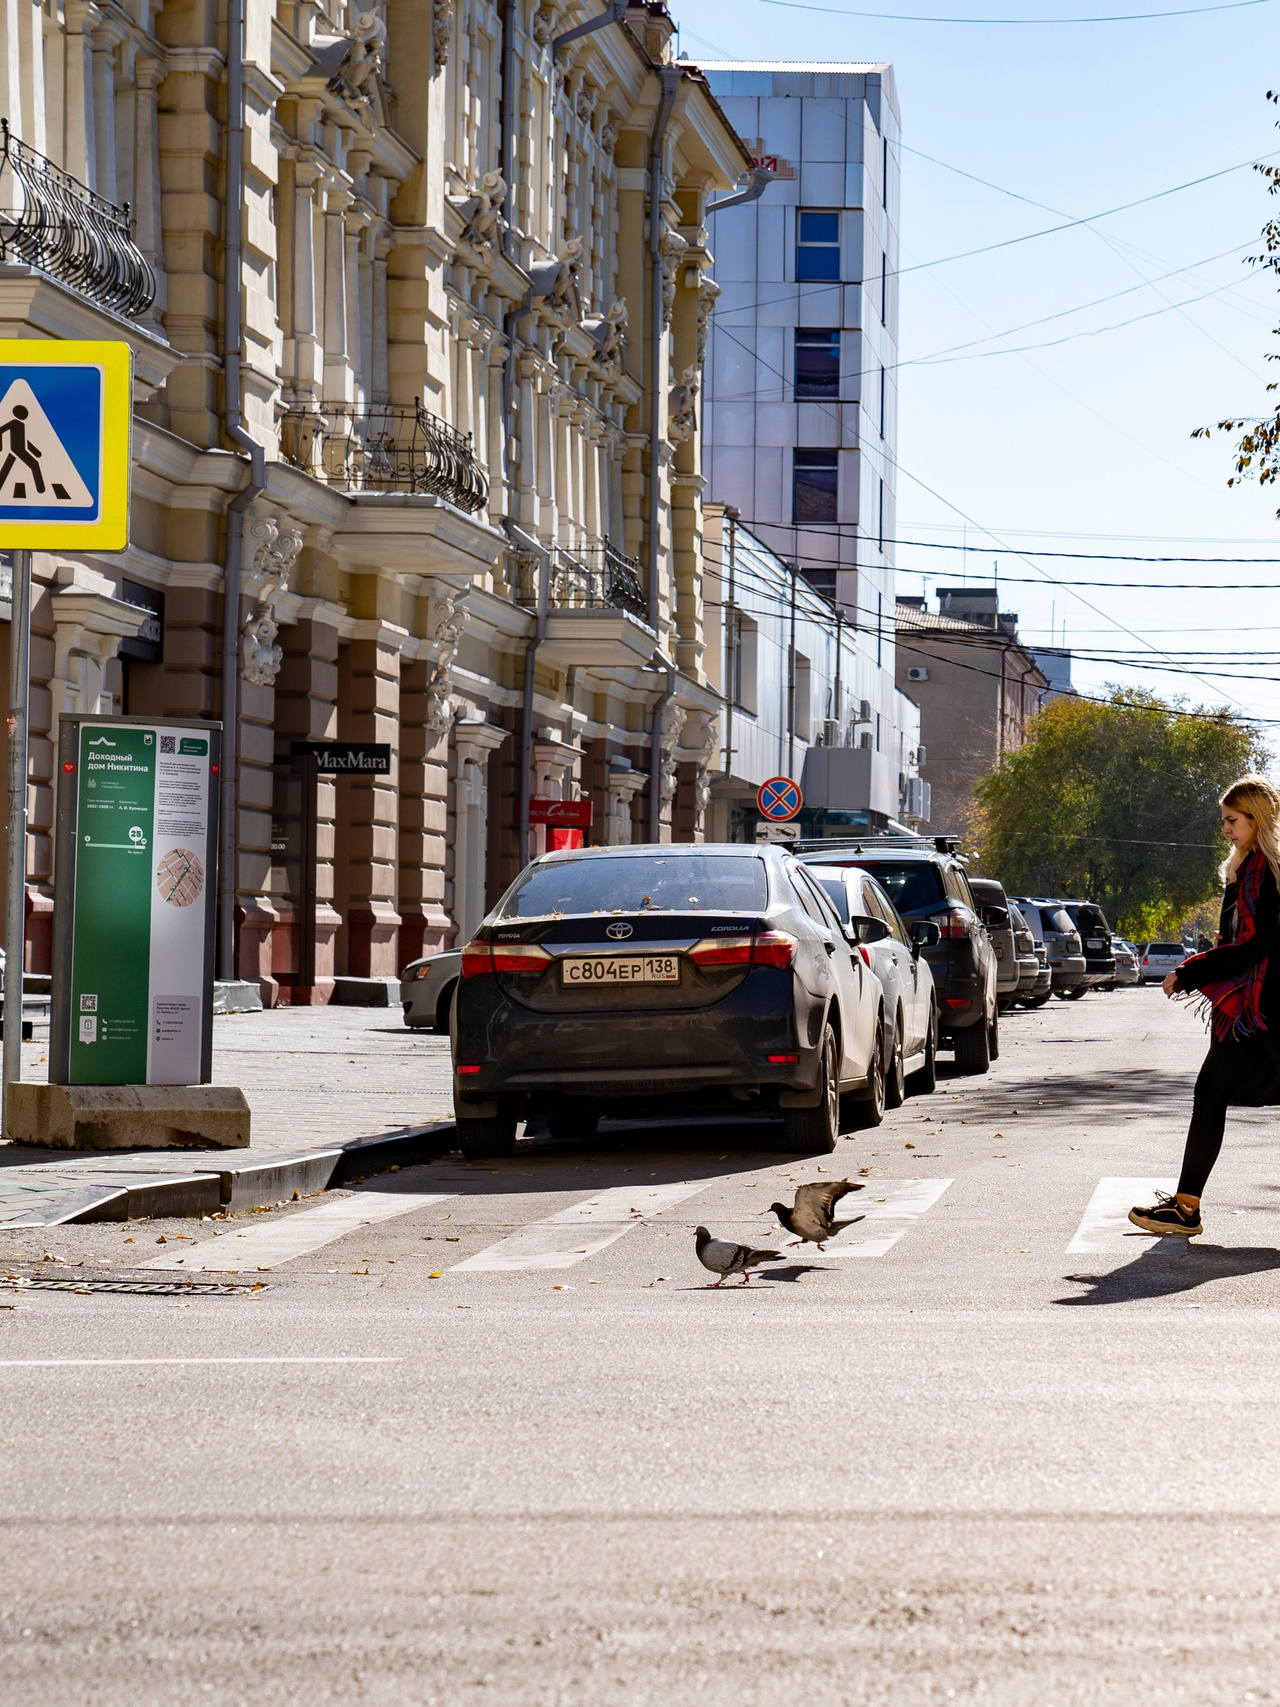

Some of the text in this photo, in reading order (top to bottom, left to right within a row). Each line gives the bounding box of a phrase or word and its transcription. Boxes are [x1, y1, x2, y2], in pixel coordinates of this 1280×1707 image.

[88, 752, 133, 761] Доходный
[313, 751, 386, 768] MaxMara
[107, 763, 149, 772] Никитина
[131, 830, 142, 838] 25
[569, 959, 673, 980] С804ЕР 138
